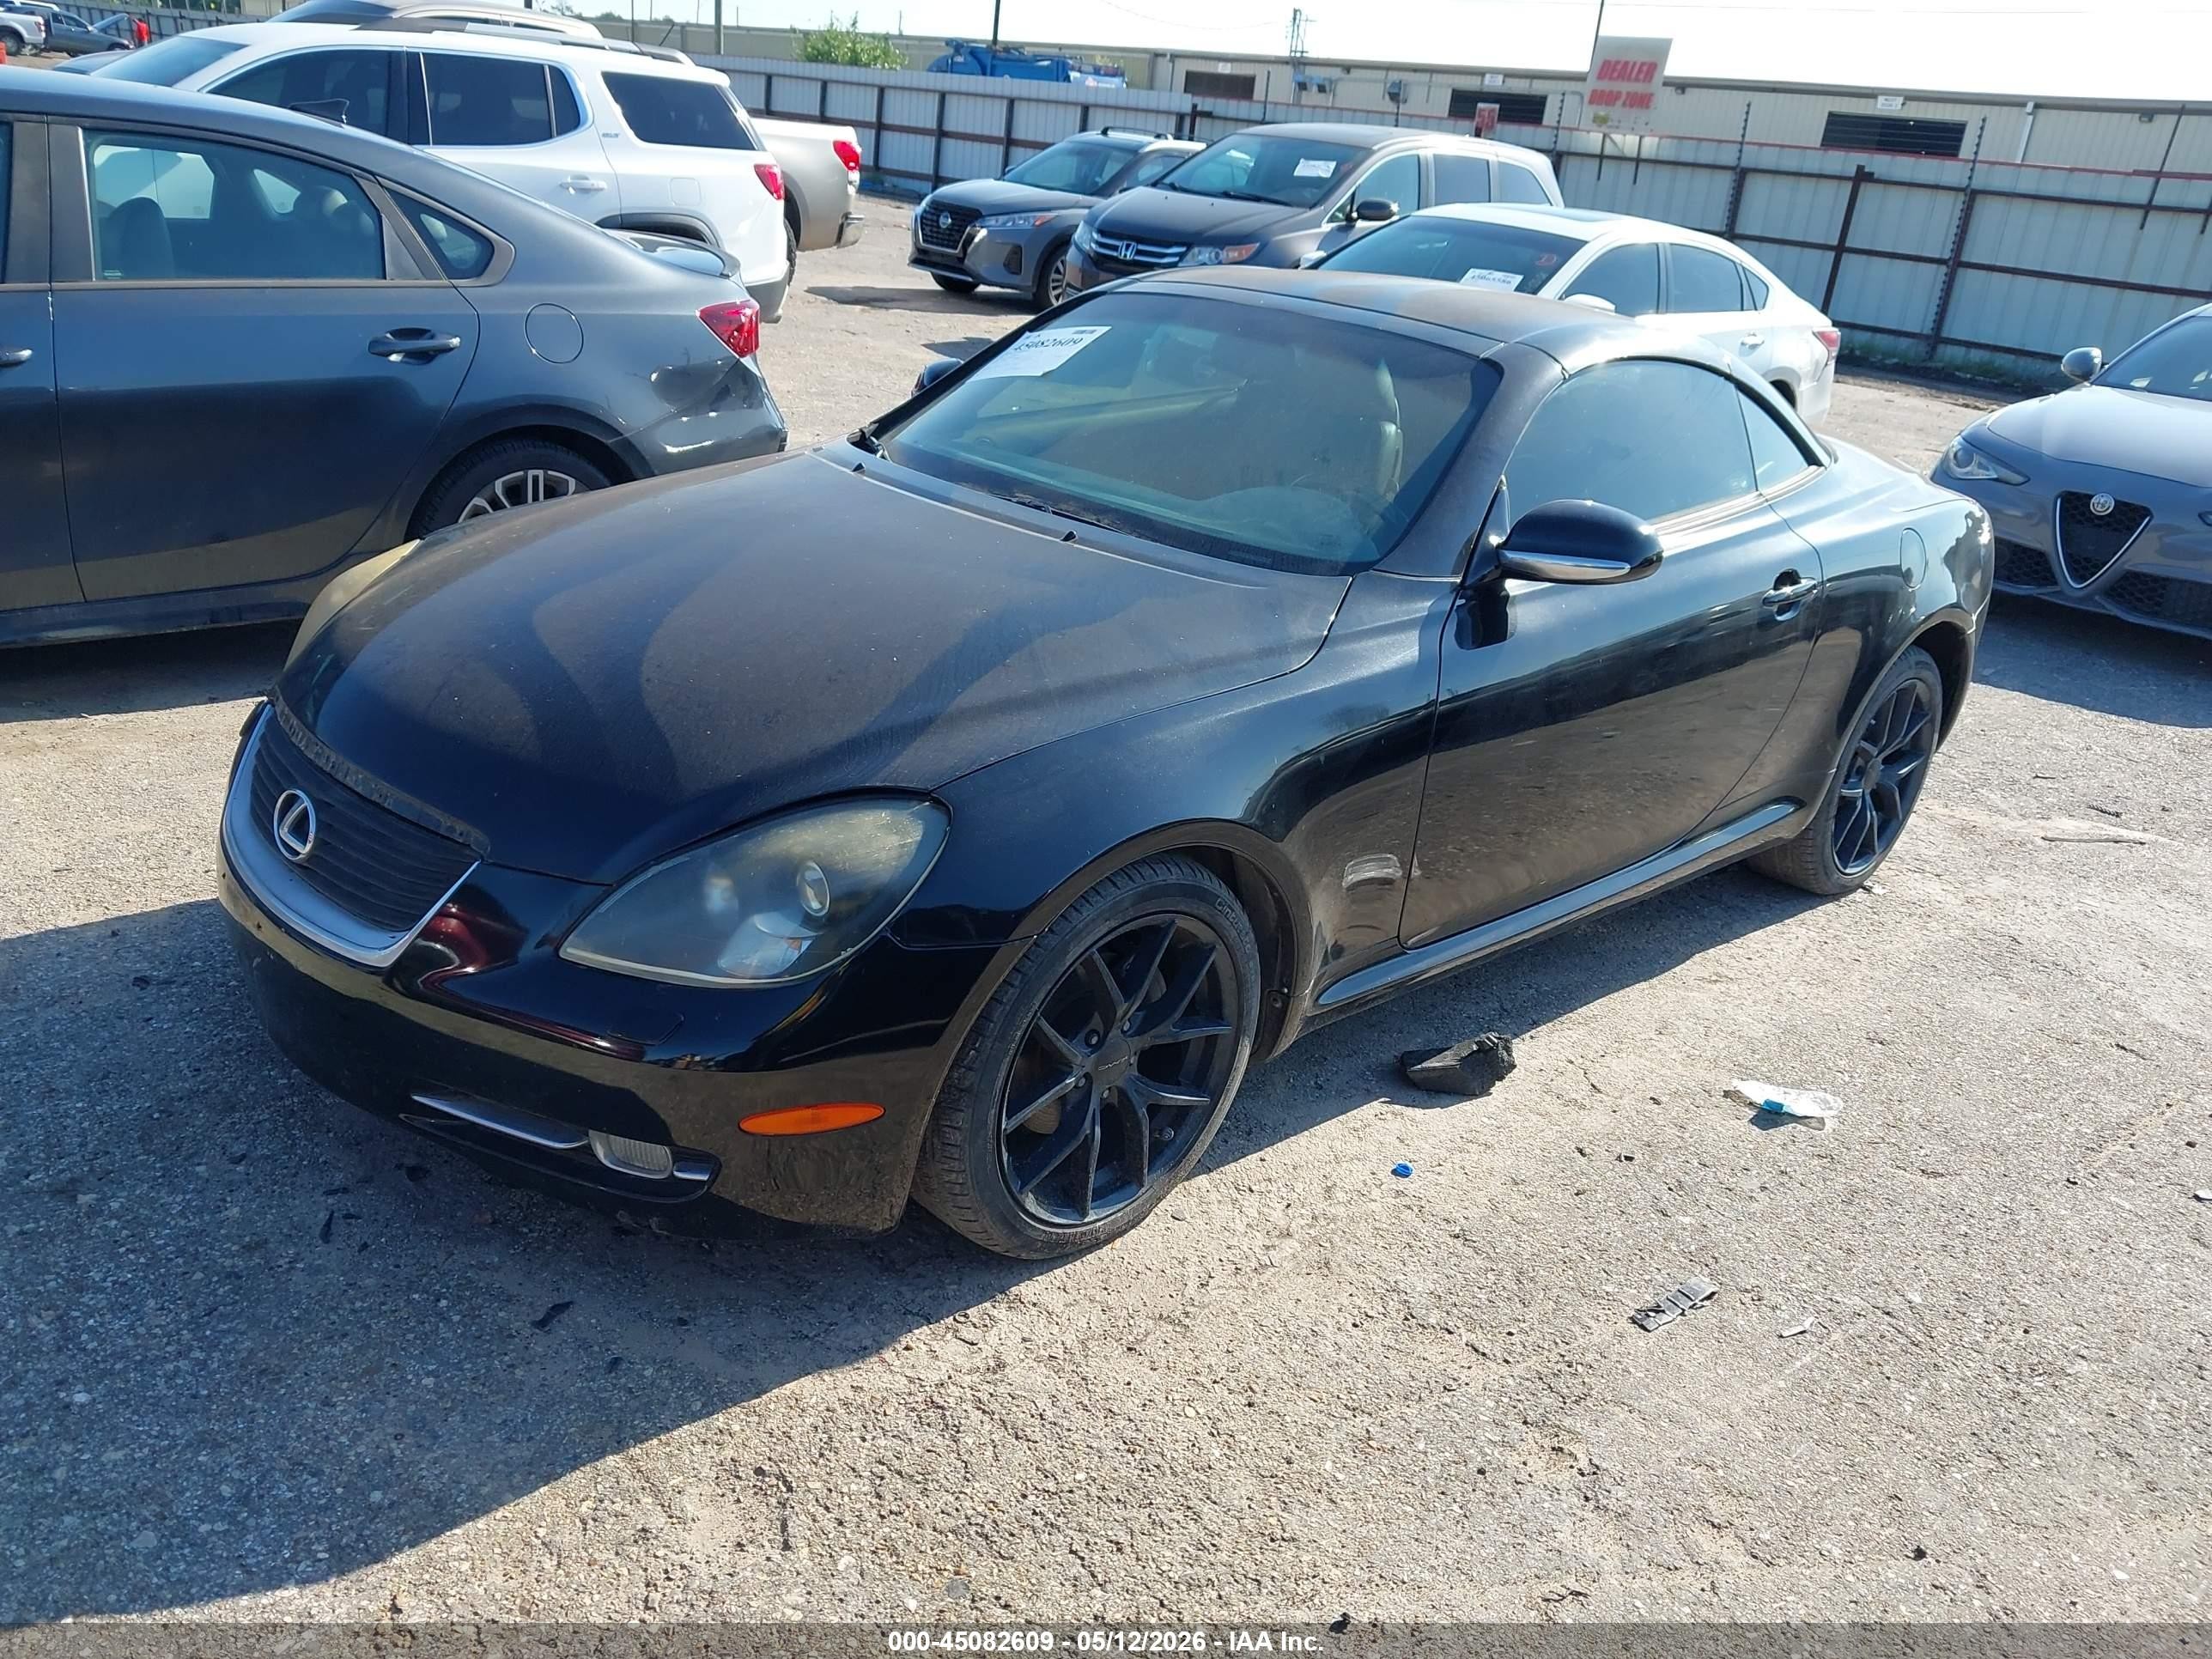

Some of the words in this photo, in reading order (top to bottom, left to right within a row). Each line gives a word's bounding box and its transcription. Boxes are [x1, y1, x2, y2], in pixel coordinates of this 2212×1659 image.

[1596, 59, 1657, 82] DEALER
[1588, 88, 1622, 107] DROP
[1621, 90, 1656, 110] ZONE
